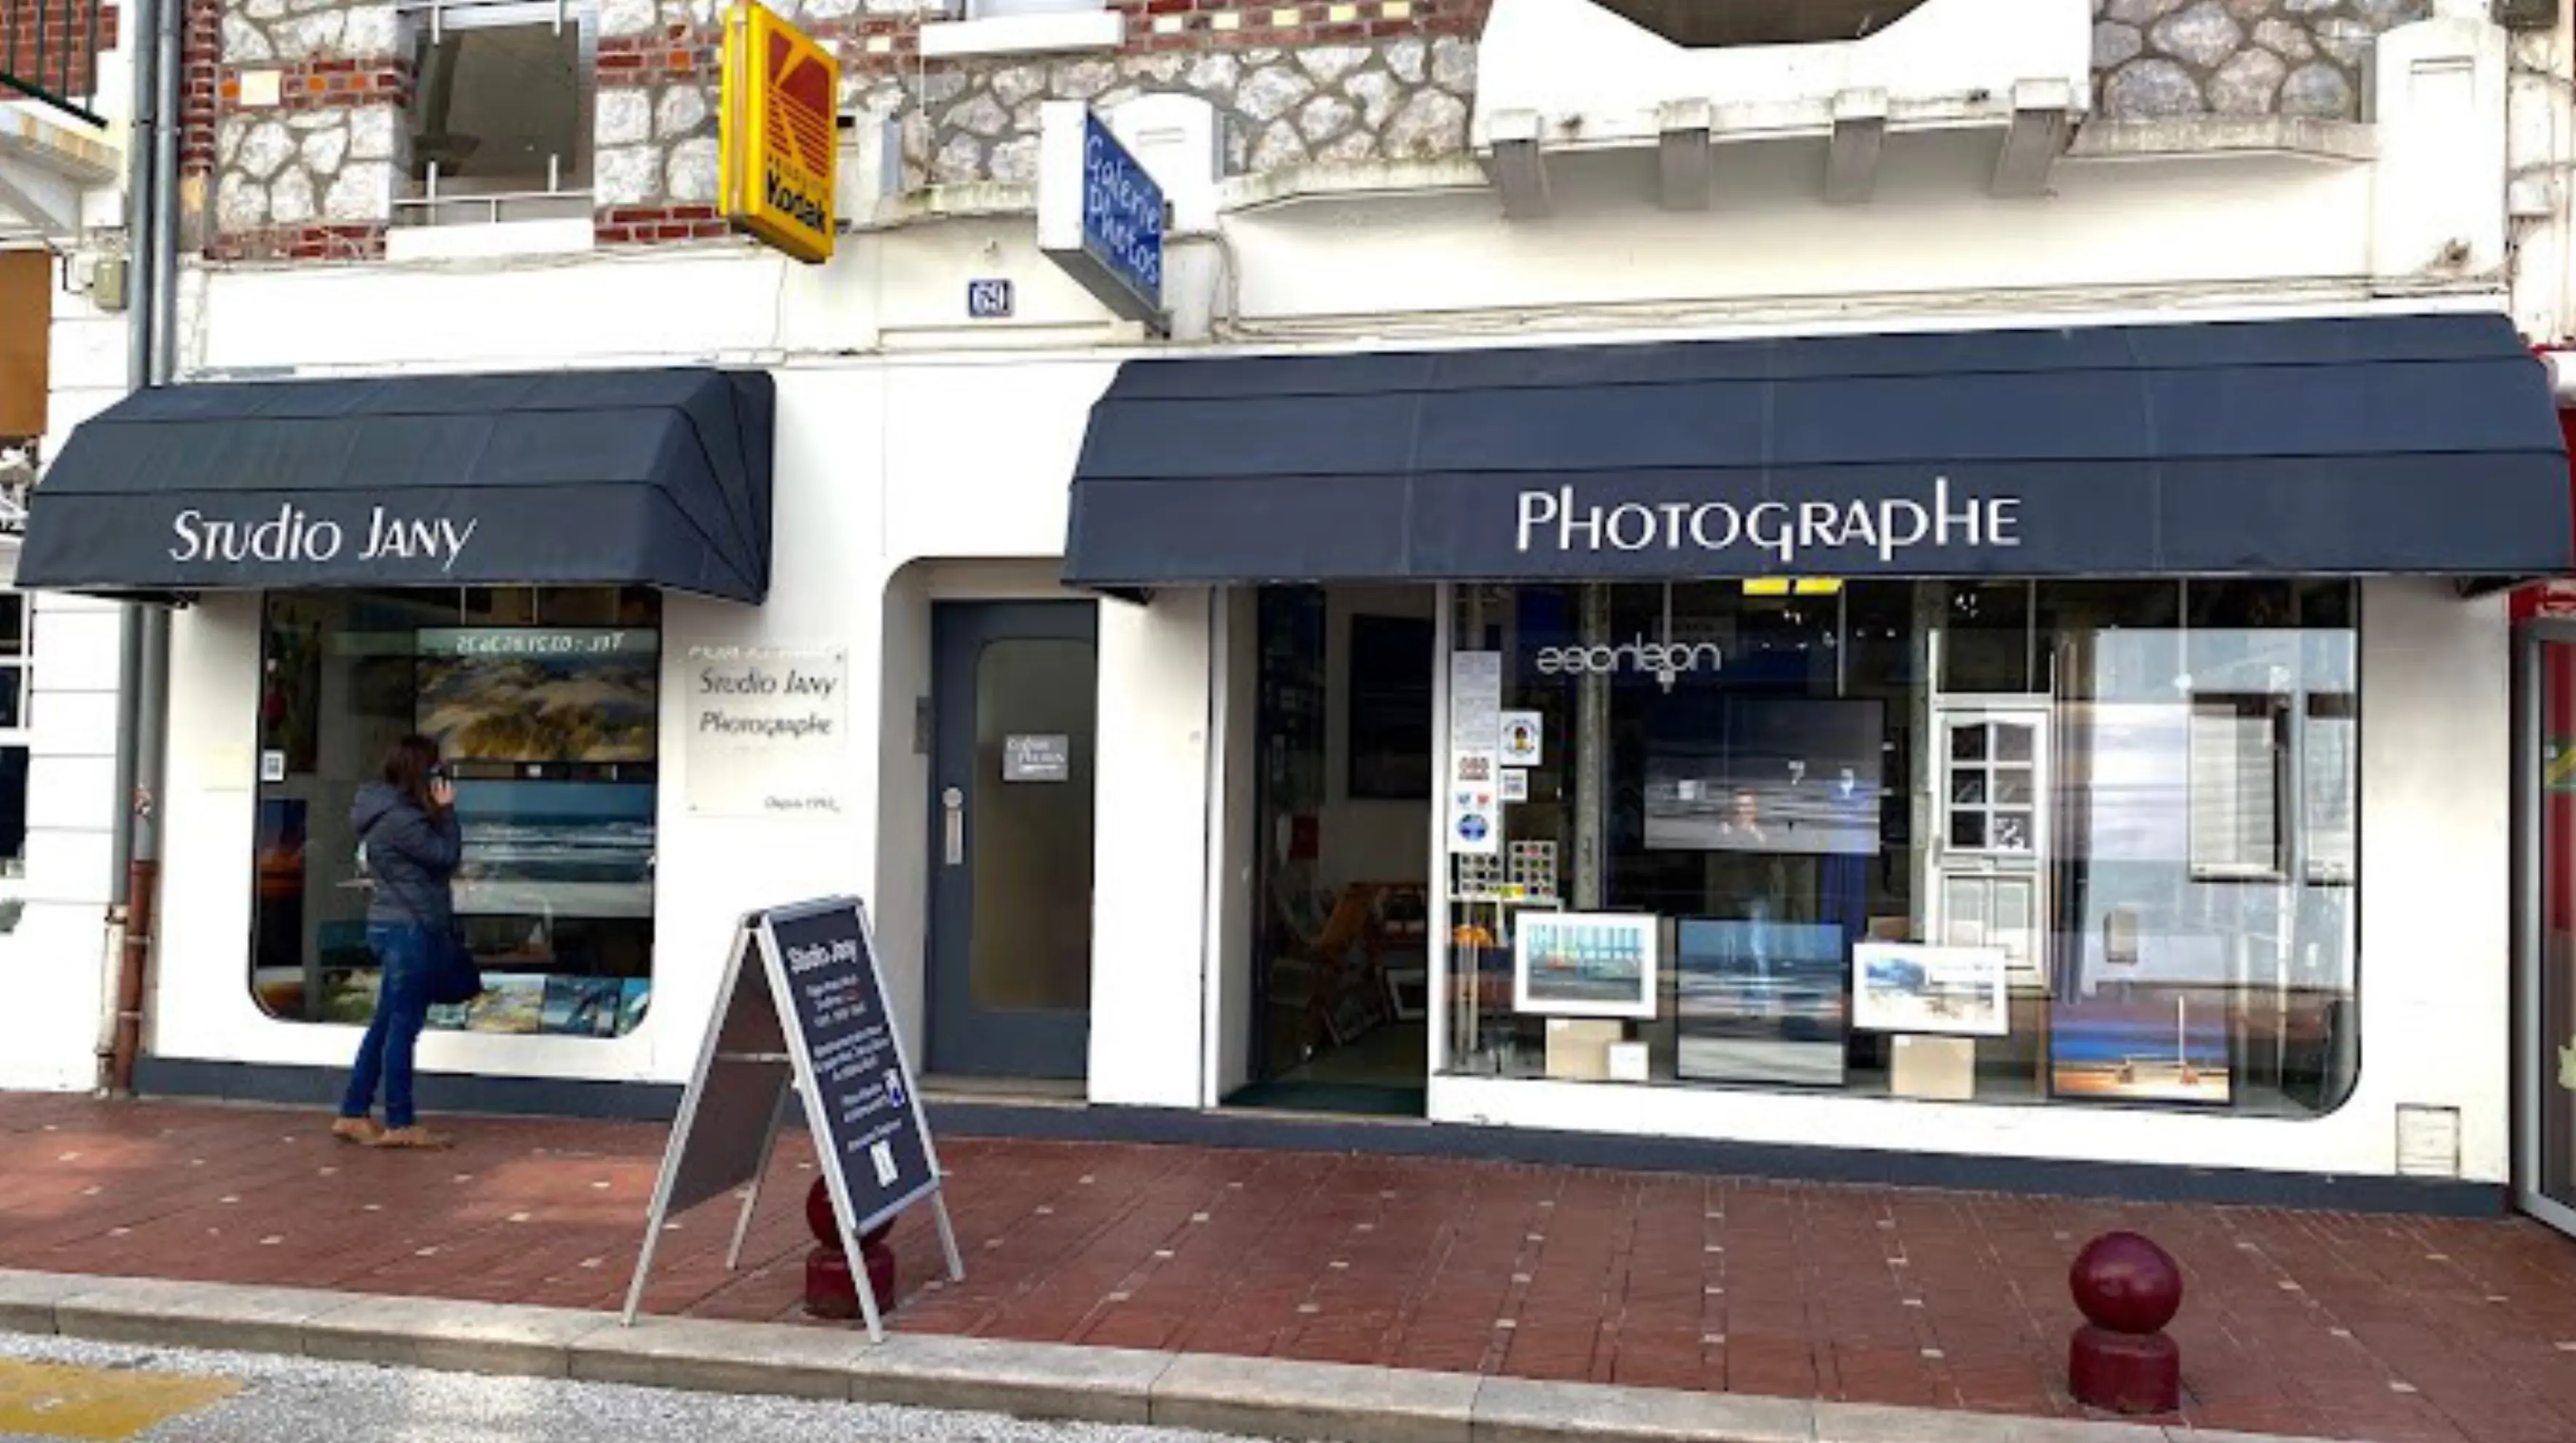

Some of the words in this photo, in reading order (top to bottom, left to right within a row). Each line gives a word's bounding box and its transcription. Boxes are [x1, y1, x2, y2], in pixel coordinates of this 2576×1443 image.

[768, 168, 826, 235] Kodak
[1087, 134, 1159, 235] Galerie
[1090, 184, 1159, 284] Photos
[972, 283, 1004, 312] 69
